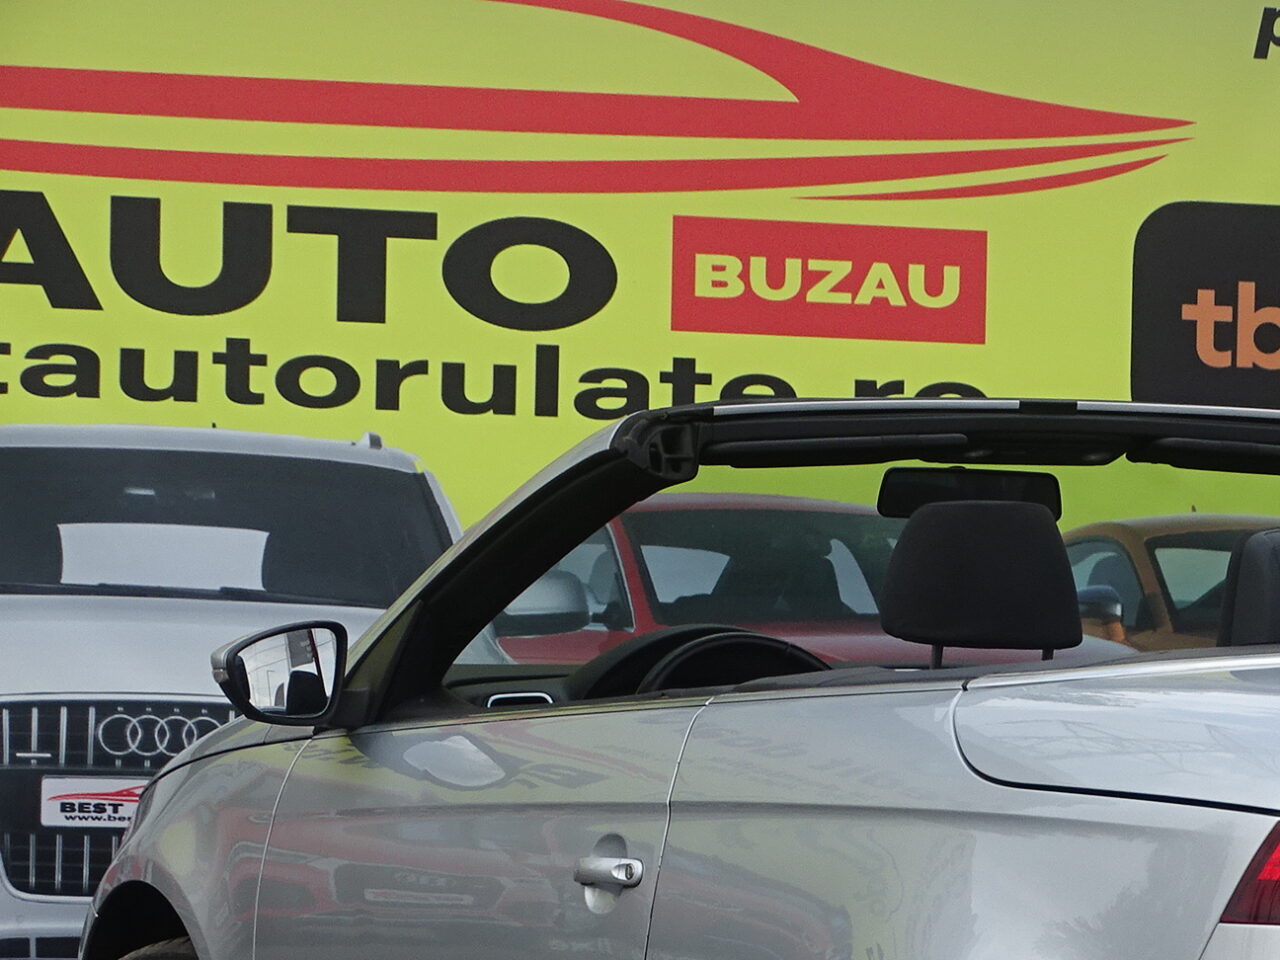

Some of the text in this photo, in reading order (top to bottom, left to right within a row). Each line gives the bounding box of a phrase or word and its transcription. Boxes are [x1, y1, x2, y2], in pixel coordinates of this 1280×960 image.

[0, 190, 618, 331] AUTO
[694, 253, 960, 308] BUZAU
[60, 802, 124, 814] BEST
